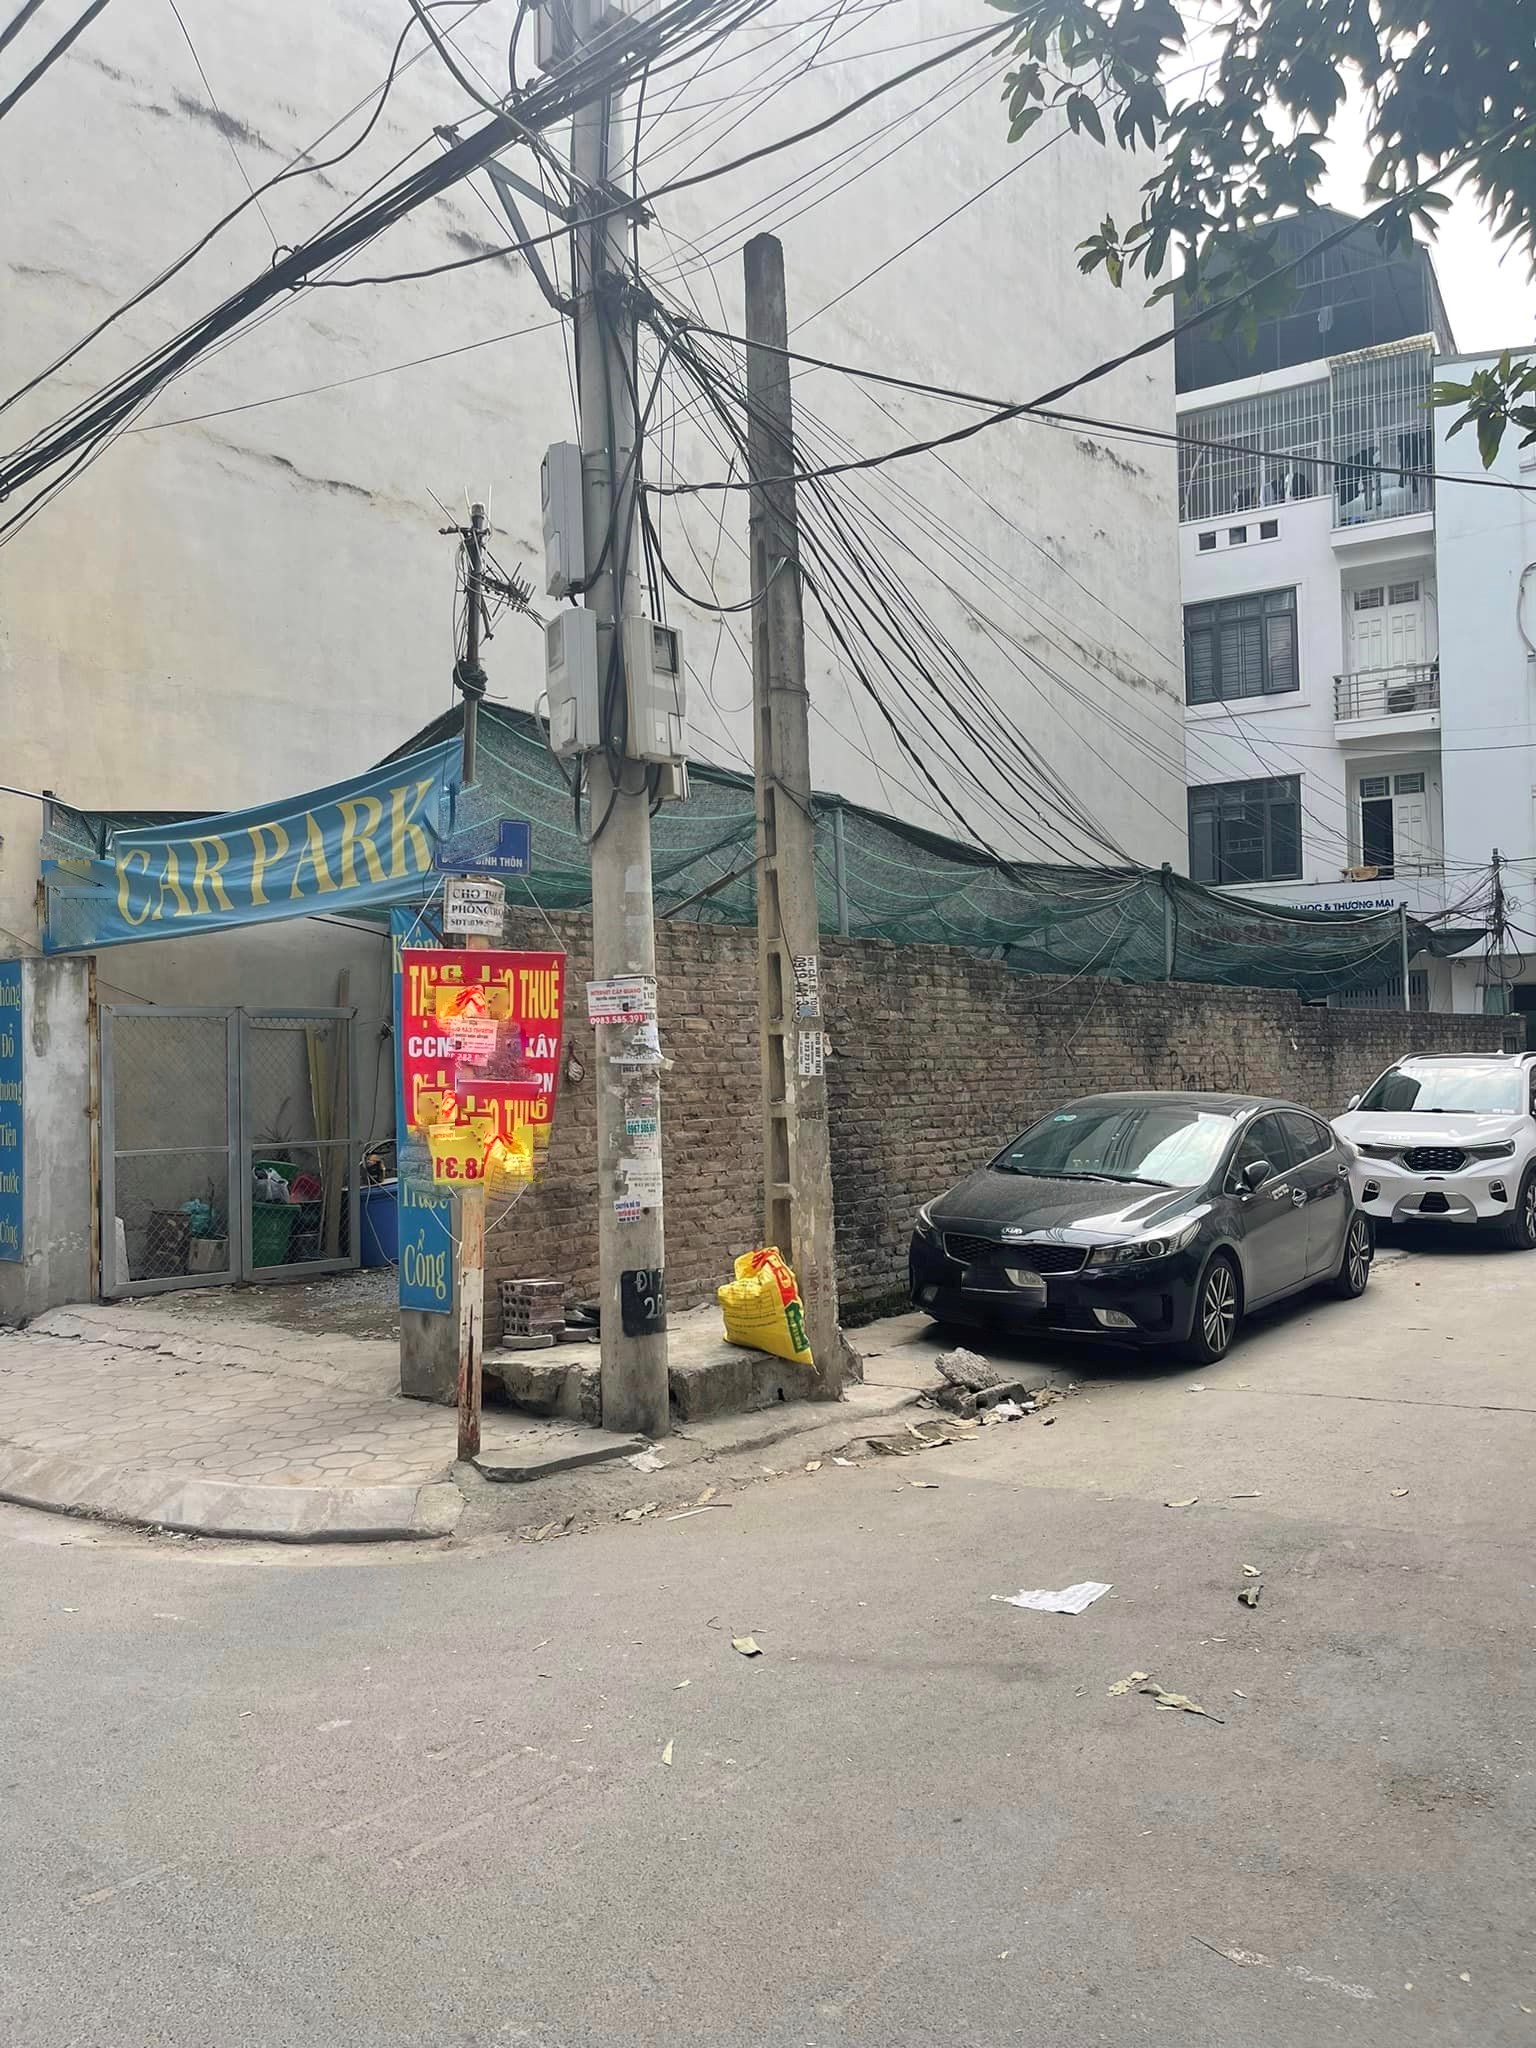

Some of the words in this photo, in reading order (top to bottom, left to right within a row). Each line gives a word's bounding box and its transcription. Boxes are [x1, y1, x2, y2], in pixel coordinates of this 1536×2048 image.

[116, 835, 234, 926] CAR
[248, 777, 435, 906] PARK
[500, 855, 523, 868] THÔN
[453, 889, 480, 899] CHO
[0, 978, 22, 1011] hông
[519, 960, 560, 1019] THUÊ
[404, 1228, 447, 1300] Cổng
